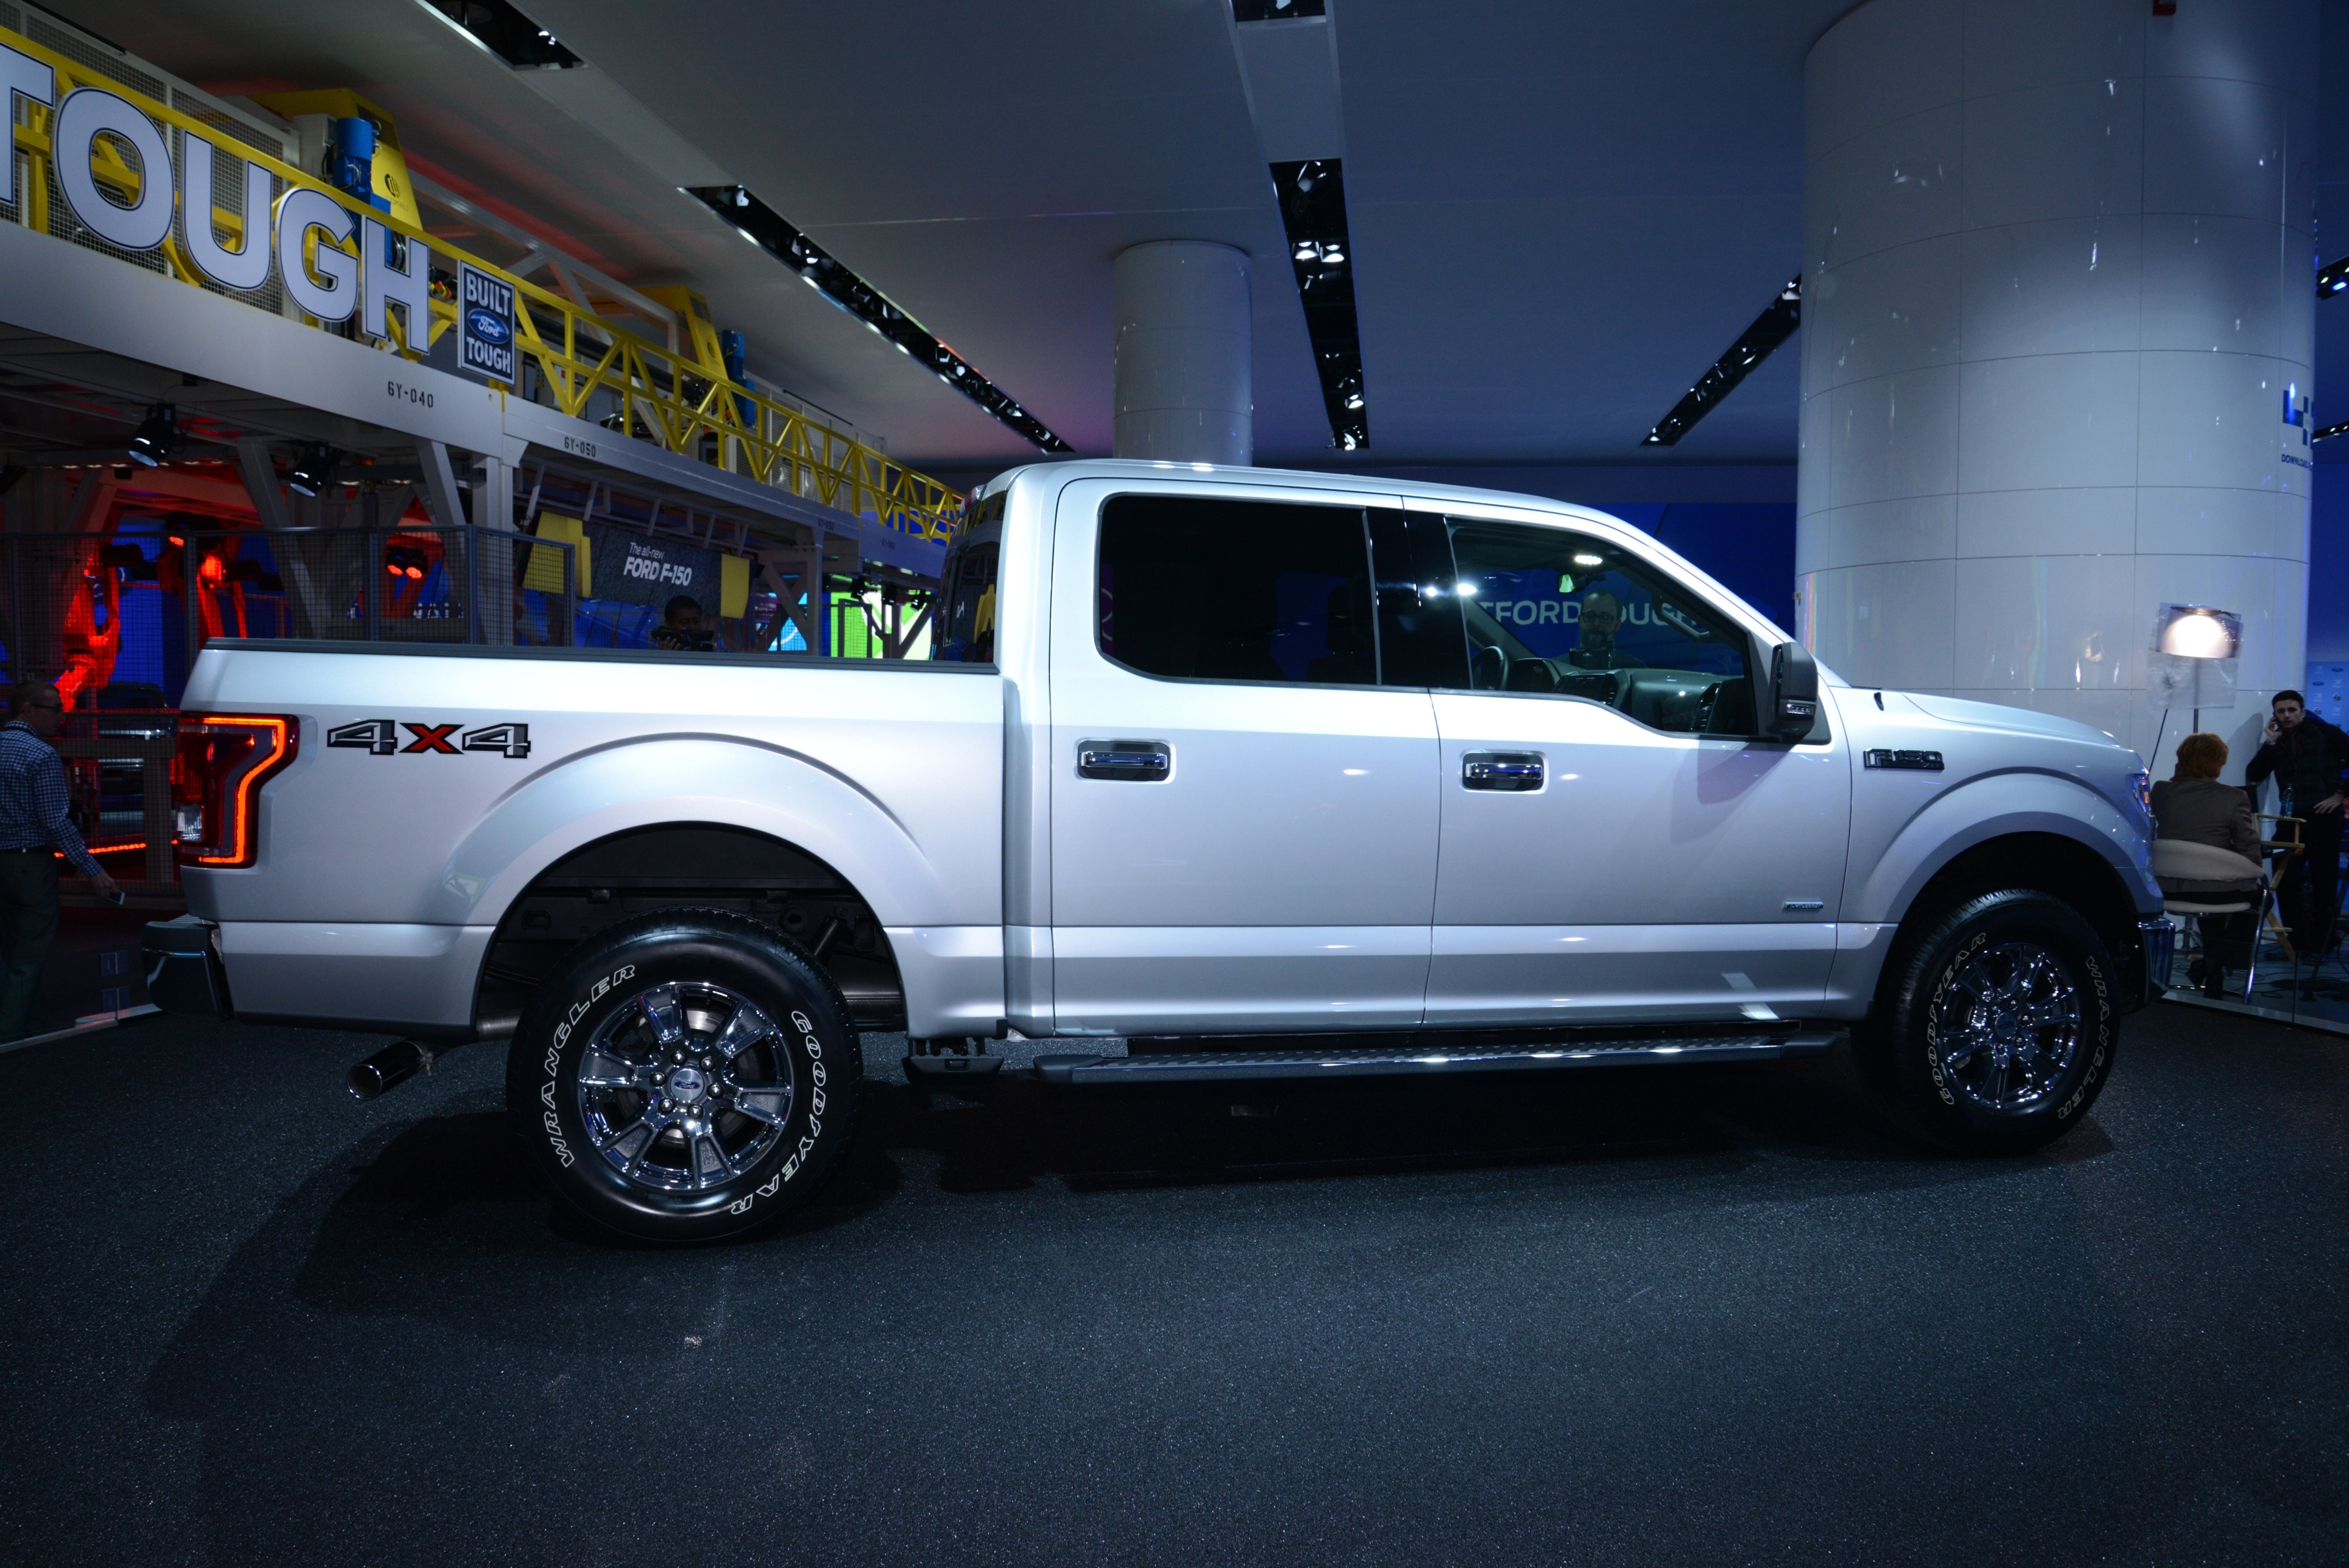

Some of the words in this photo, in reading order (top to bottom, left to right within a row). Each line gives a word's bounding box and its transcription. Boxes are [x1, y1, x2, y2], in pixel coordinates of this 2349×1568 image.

[466, 272, 511, 317] BUILT
[478, 315, 500, 337] Ford
[466, 336, 511, 374] TOUGH
[387, 381, 433, 408] 6Y-040
[565, 436, 596, 457] 6Y-050
[629, 542, 642, 556] The
[641, 545, 665, 559] all-new
[623, 556, 660, 580] FORD
[659, 563, 692, 586] F-150
[1927, 932, 1987, 1105] GOODYEAR
[2057, 955, 2109, 1119] WRANGLER
[541, 964, 635, 1168] WRANGLER
[731, 1010, 826, 1215] GOODYEAR
